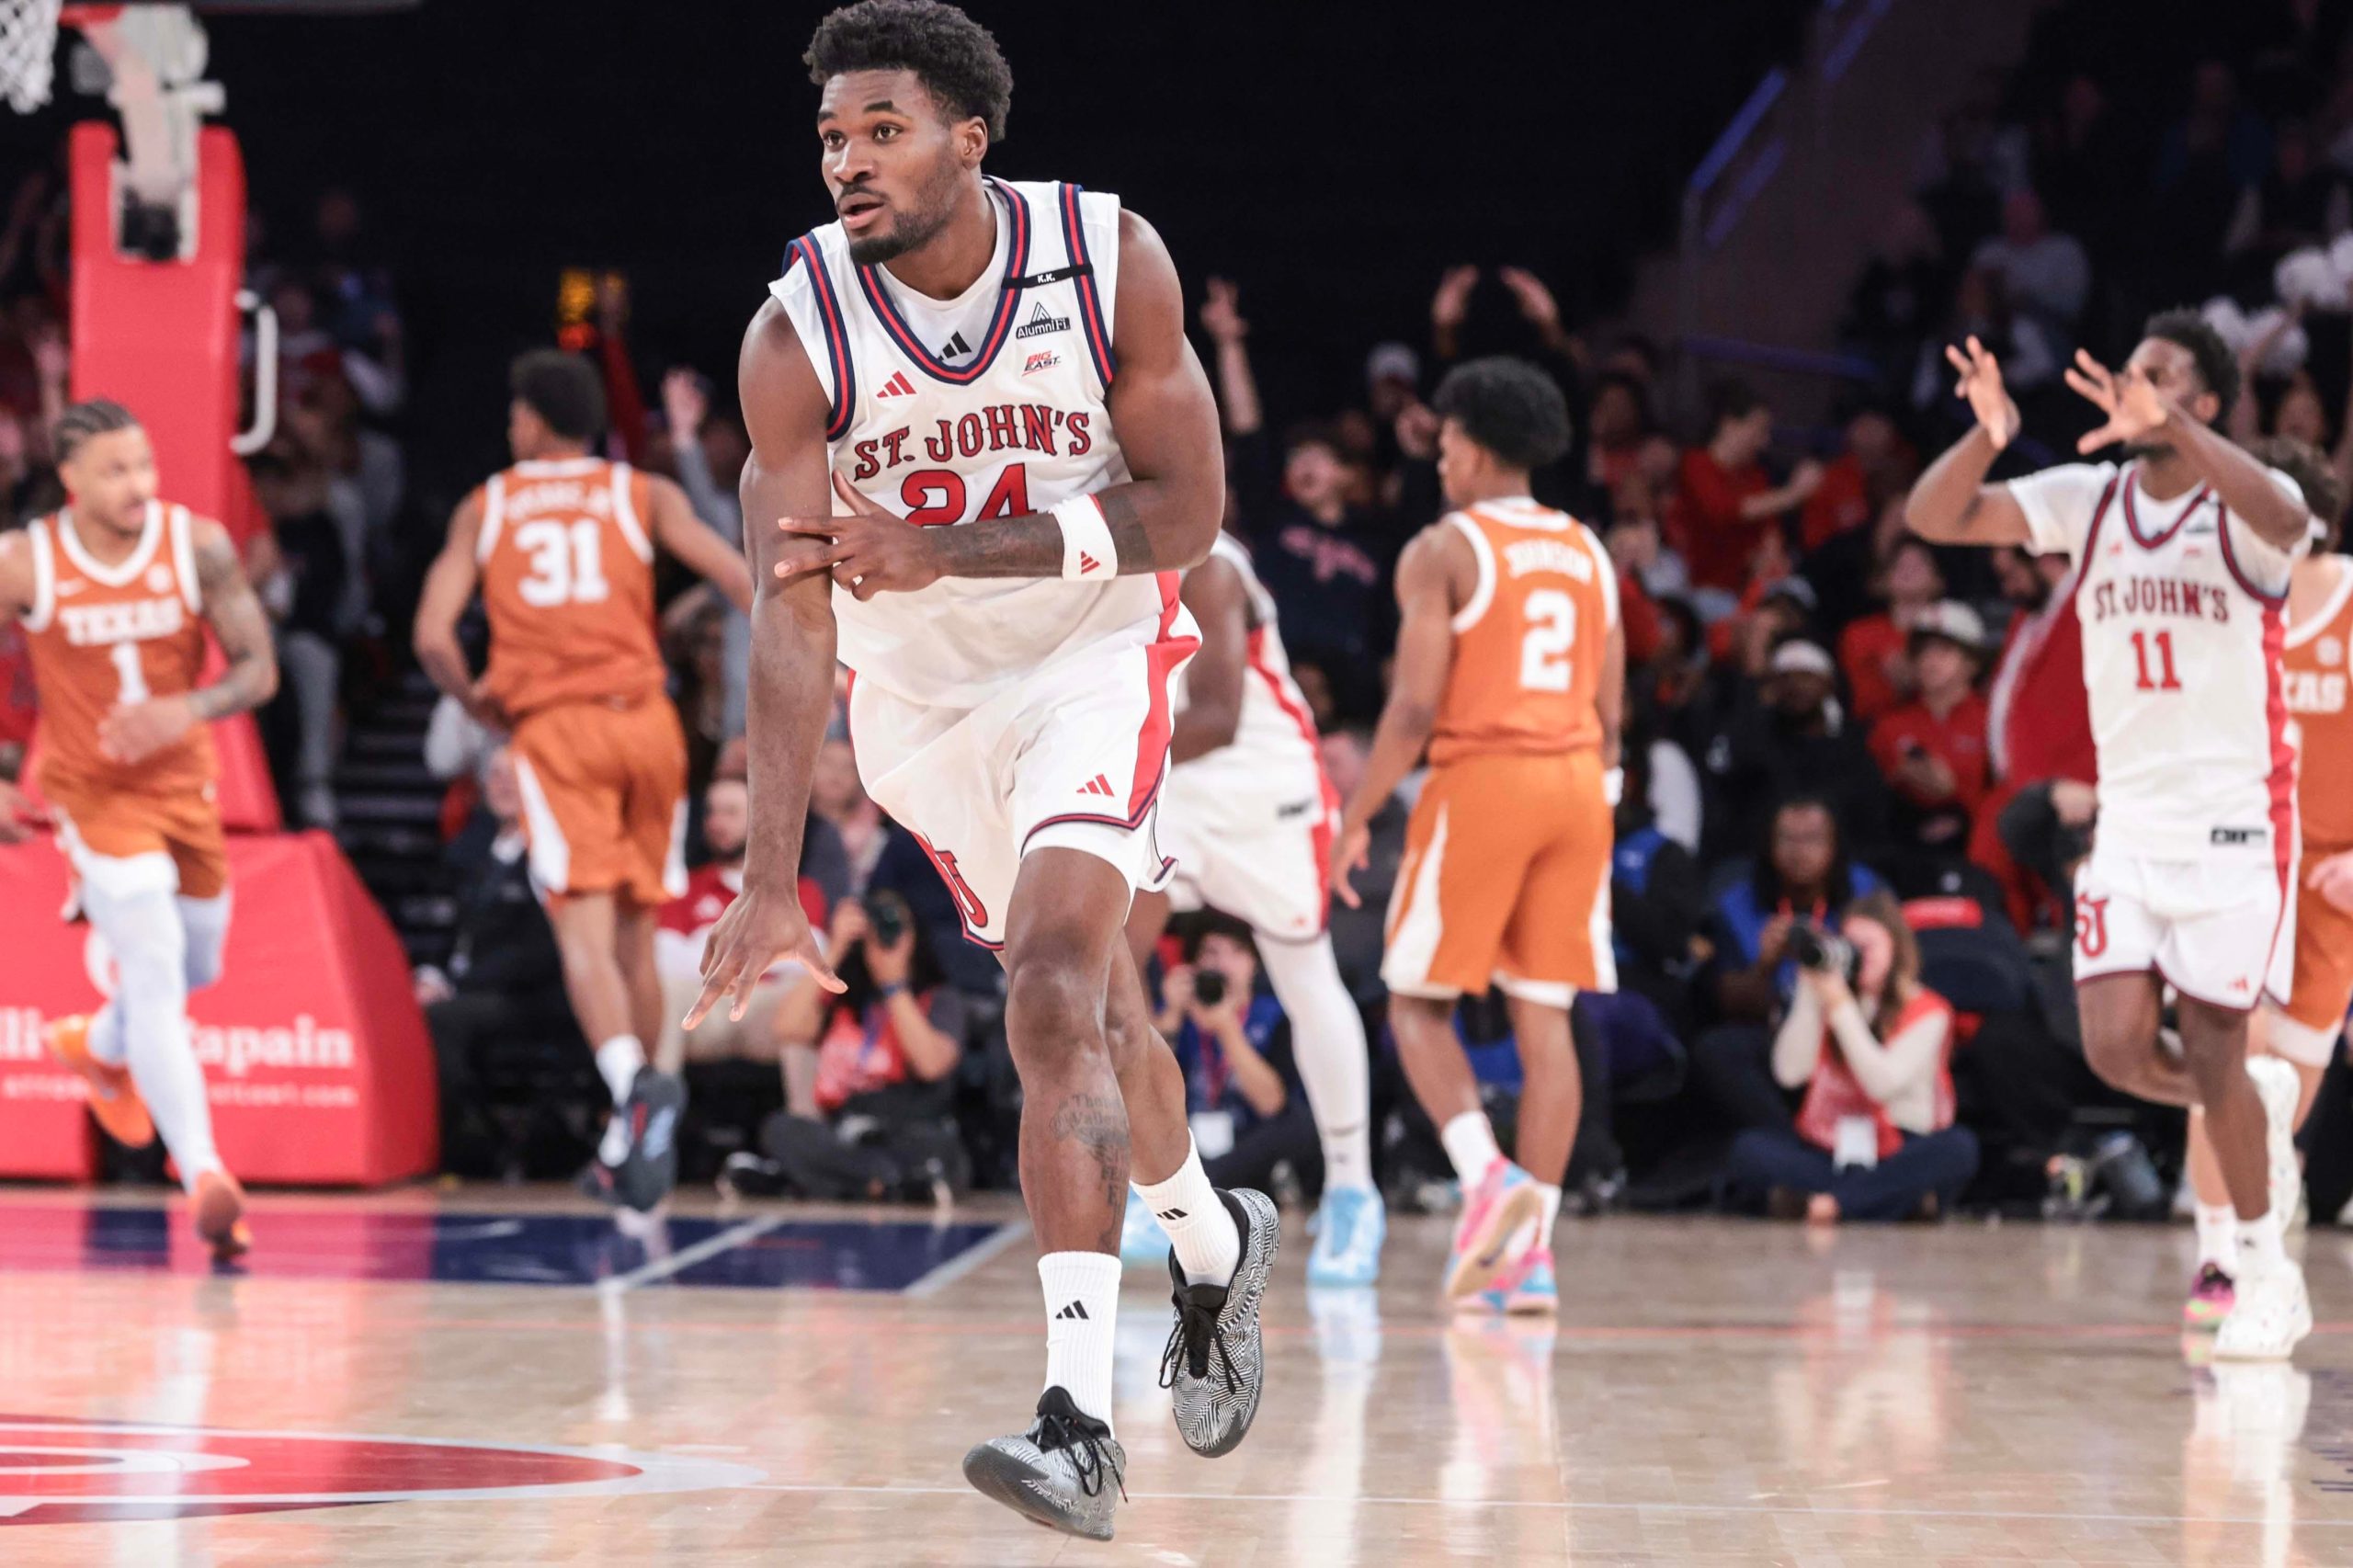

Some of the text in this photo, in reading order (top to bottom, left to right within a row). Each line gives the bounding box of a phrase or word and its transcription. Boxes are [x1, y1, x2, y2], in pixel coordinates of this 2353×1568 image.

[1037, 273, 1056, 284] K.K.
[1024, 356, 1061, 372] EAST
[1027, 350, 1052, 363] BIG
[854, 404, 1092, 482] ST. JOHN'S
[900, 462, 1038, 528] 24
[515, 517, 610, 608] 31
[58, 596, 184, 646] TEXAS
[2124, 575, 2229, 623] JOHN'S
[1520, 588, 1577, 693] 2
[2130, 631, 2182, 689] 11
[110, 641, 149, 705] 1
